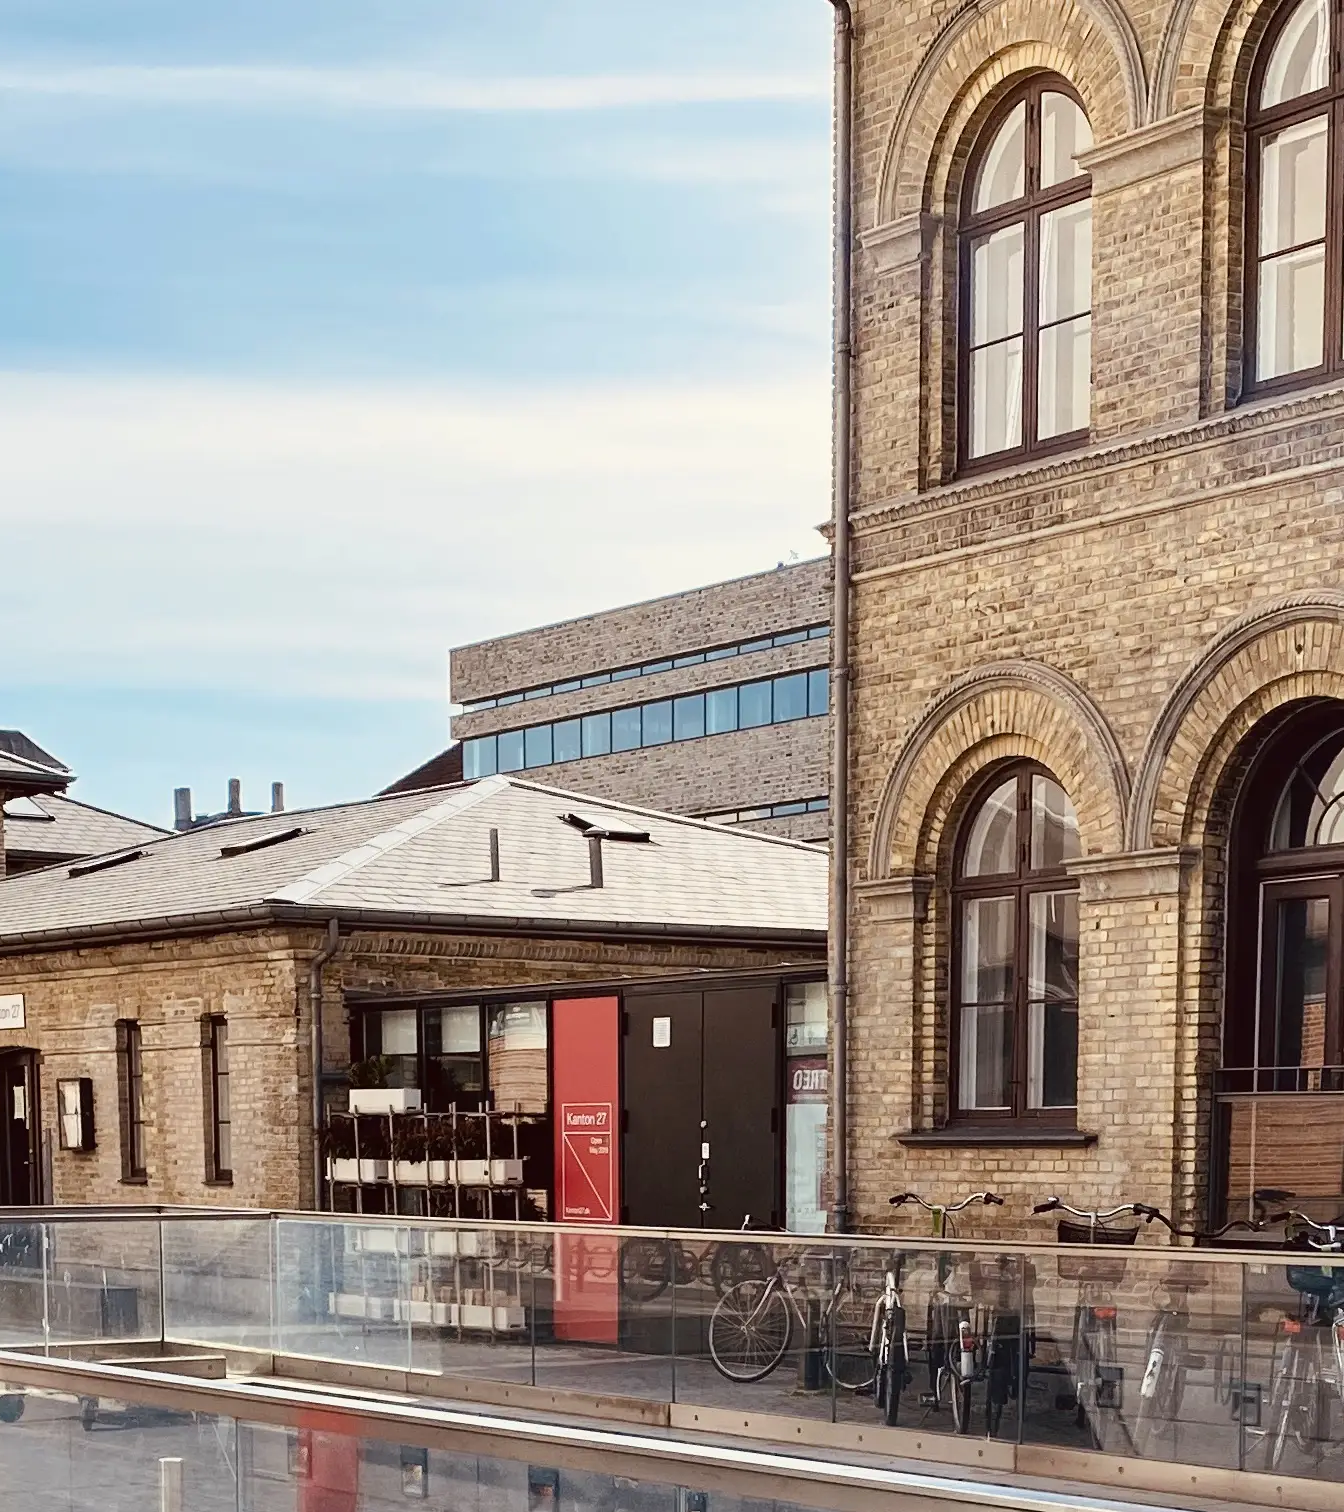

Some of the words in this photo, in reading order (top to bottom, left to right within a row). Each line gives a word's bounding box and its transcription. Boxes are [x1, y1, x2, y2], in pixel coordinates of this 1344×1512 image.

[12, 1004, 20, 1018] 27
[567, 1113, 595, 1125] Kanton
[596, 1112, 607, 1125] 27
